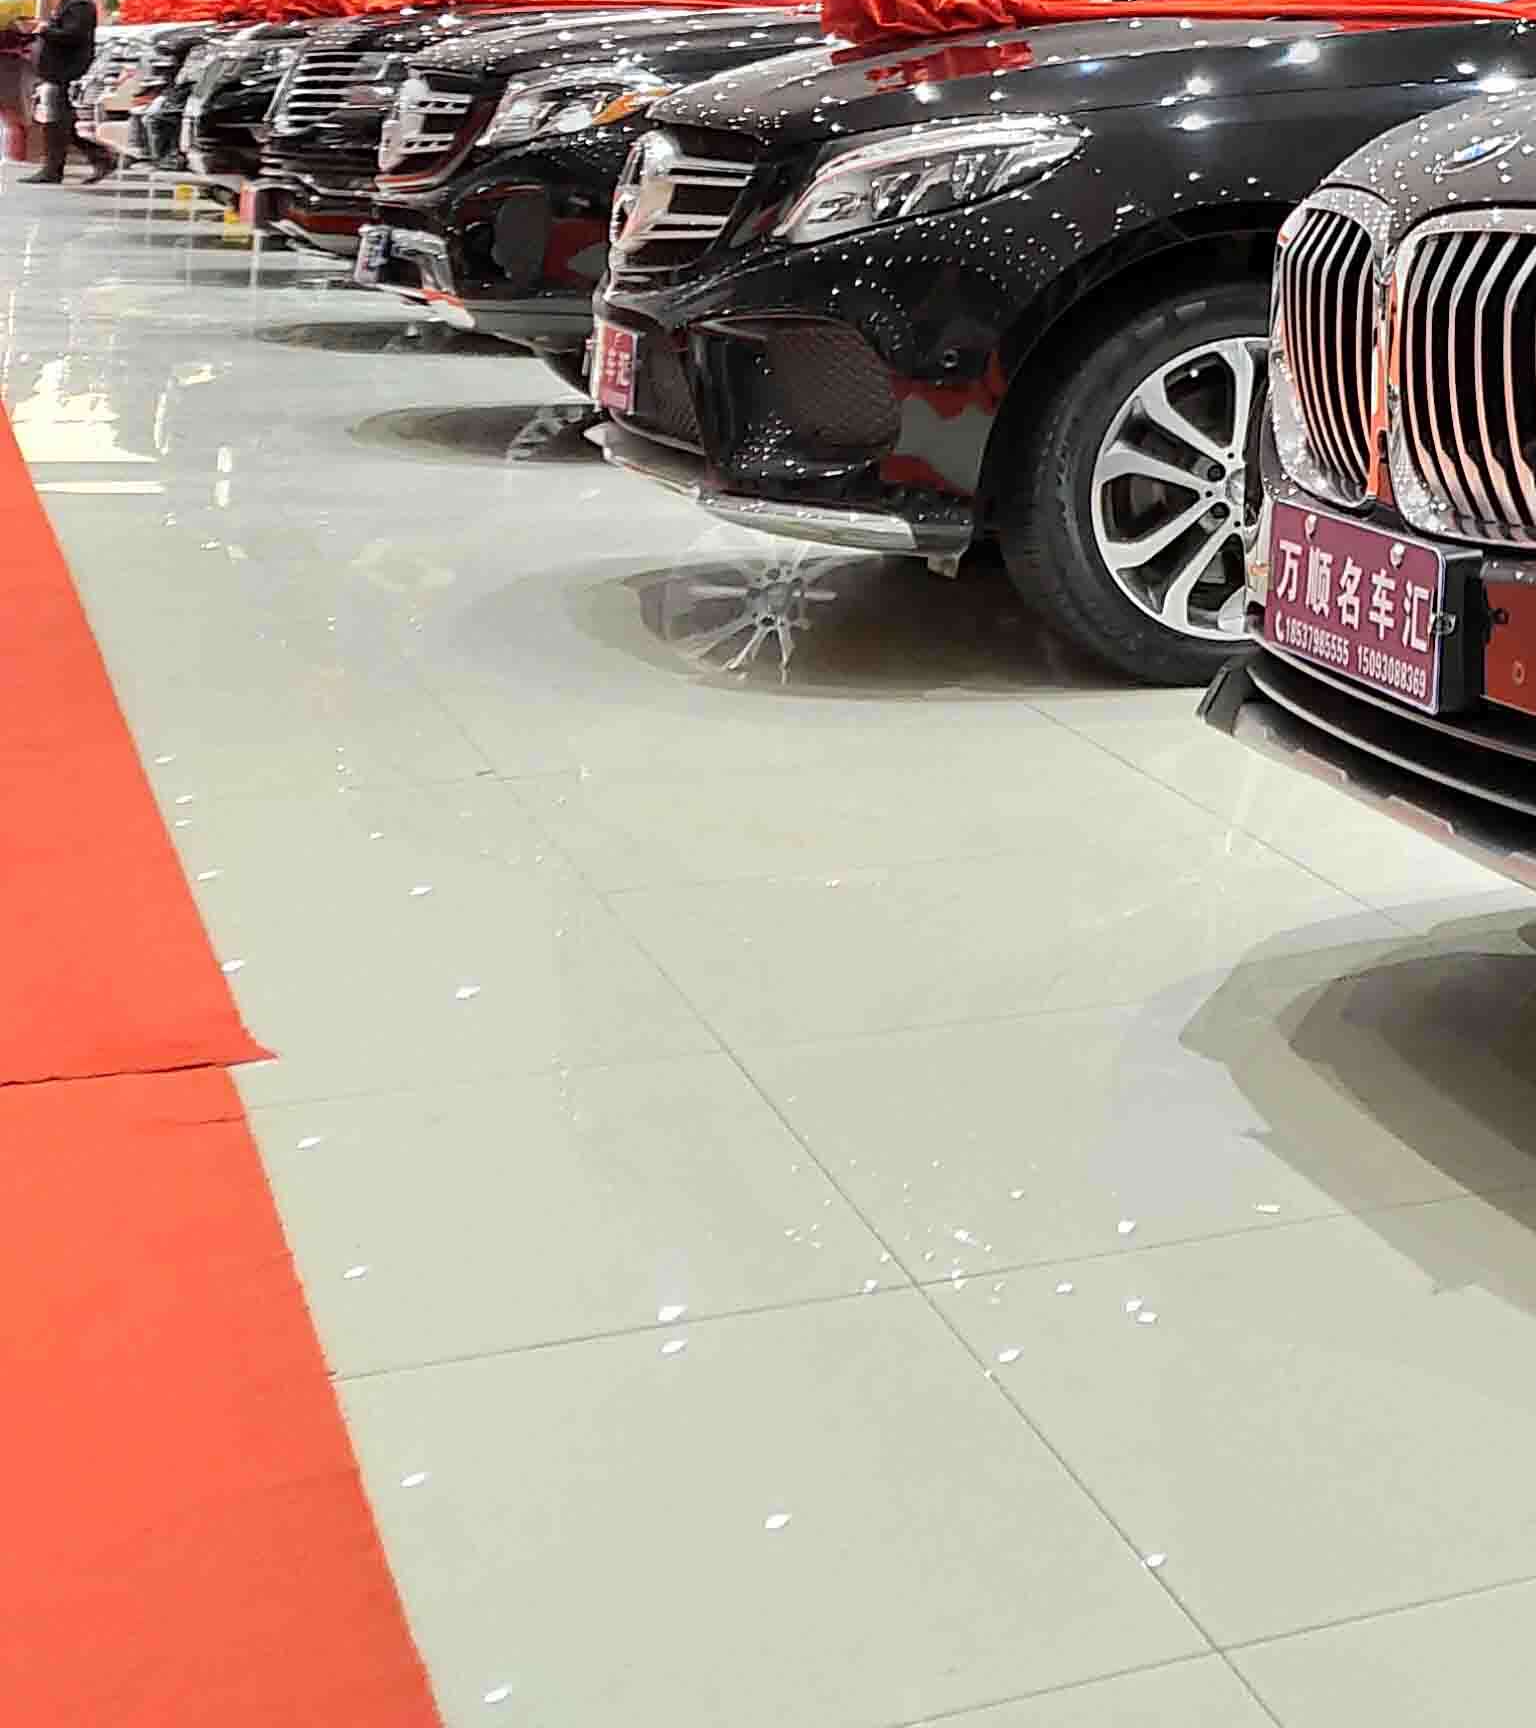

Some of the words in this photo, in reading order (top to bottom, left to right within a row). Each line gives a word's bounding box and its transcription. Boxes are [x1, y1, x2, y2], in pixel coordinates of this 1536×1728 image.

[1276, 539, 1430, 653] 万顺名车汇
[1284, 617, 1350, 667] 18537985555
[1357, 645, 1427, 698] 15093088369
